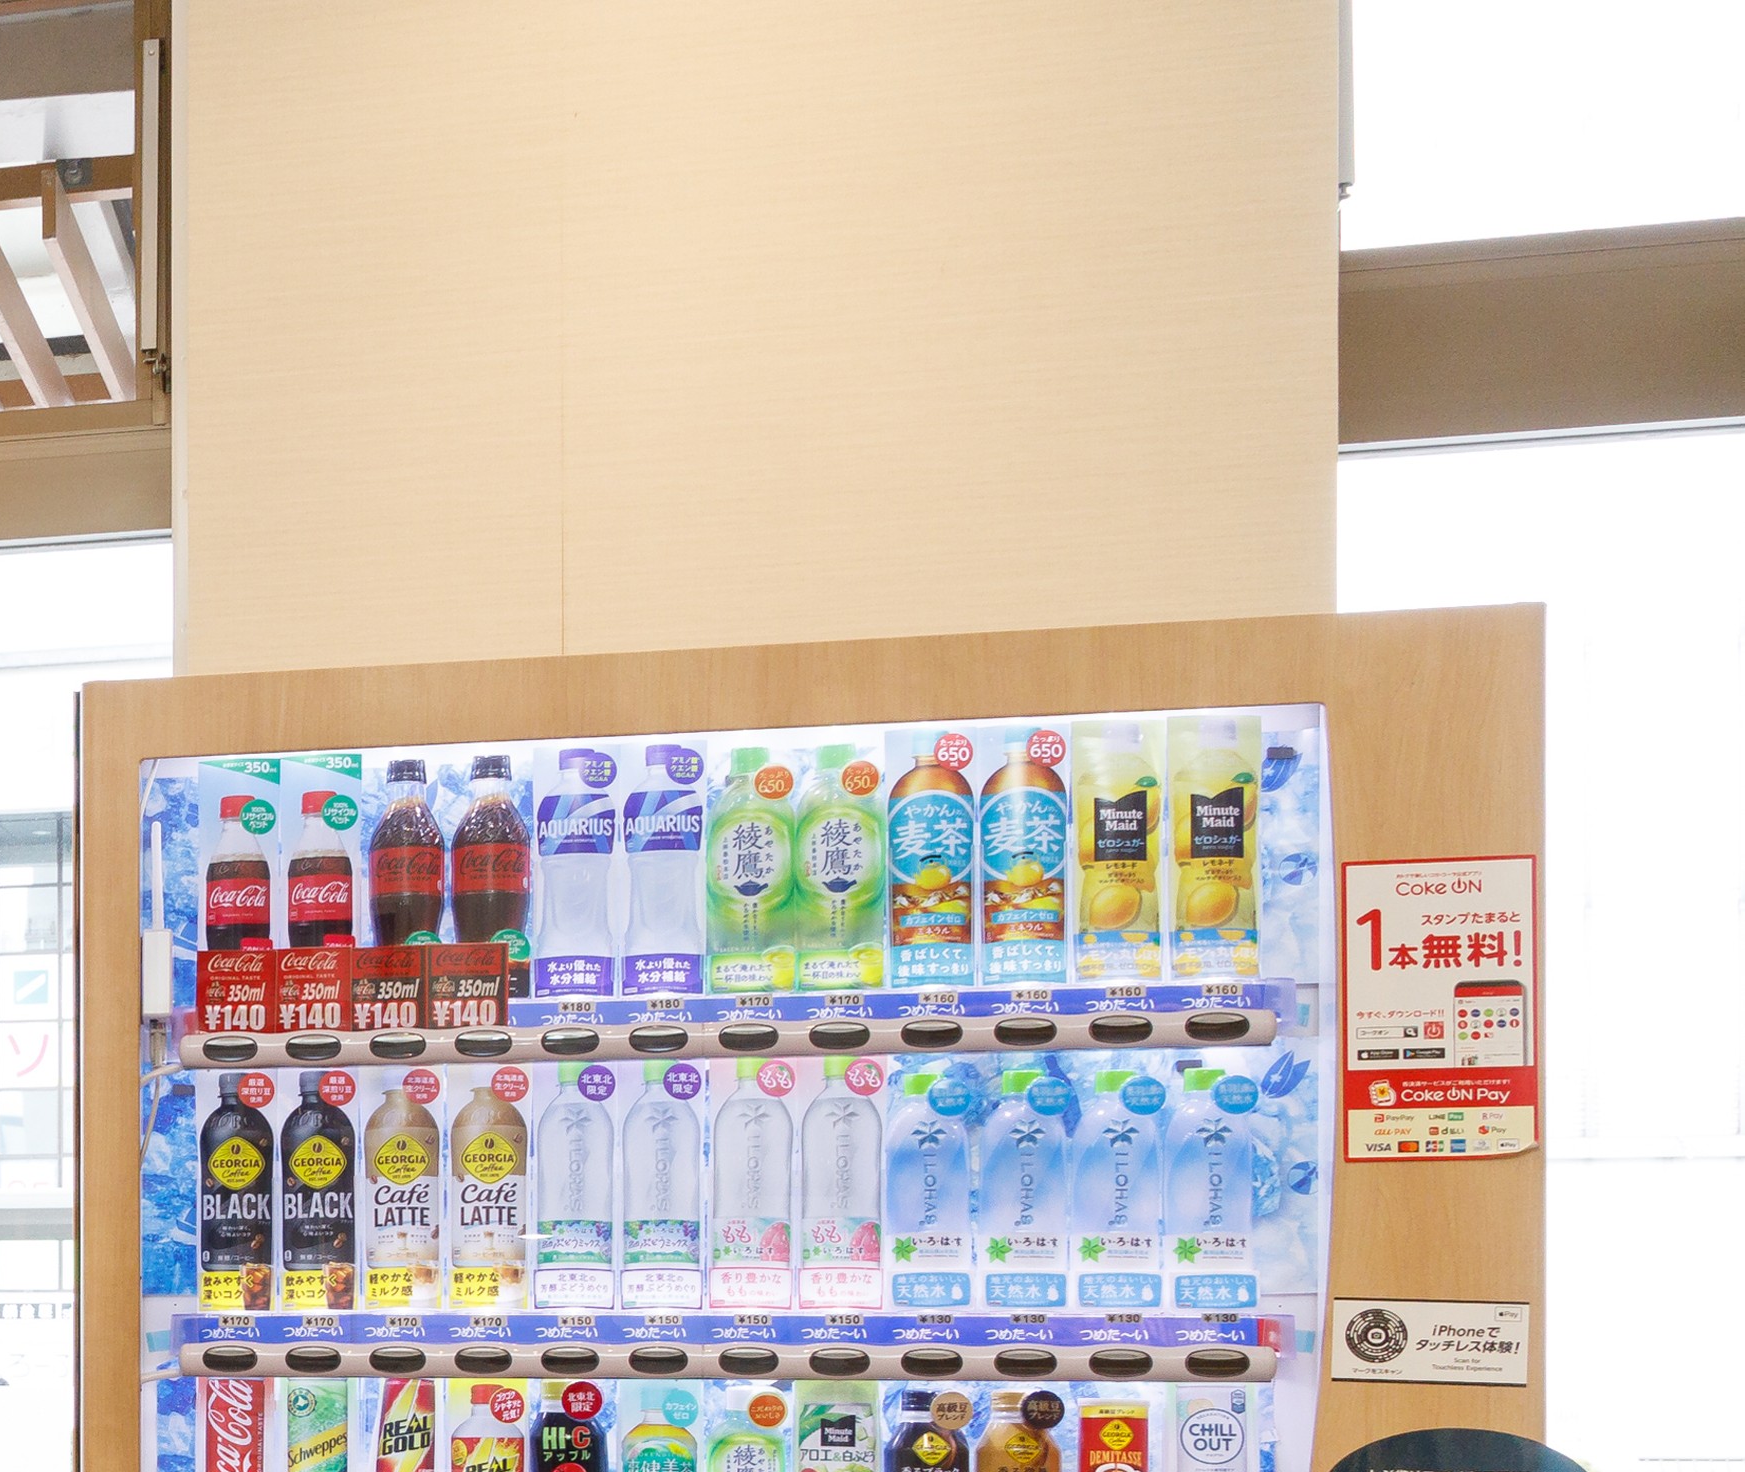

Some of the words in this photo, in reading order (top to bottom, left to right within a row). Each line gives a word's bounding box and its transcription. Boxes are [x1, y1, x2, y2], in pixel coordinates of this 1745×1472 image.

[937, 745, 971, 762] 650
[1029, 742, 1063, 760] 650
[1099, 807, 1144, 821] Minute
[1196, 804, 1241, 818] Minute
[539, 818, 614, 838] AQUARIUS
[625, 815, 702, 835] AQUARIUS
[1104, 818, 1138, 832] Maid
[1201, 814, 1235, 828] Maid
[892, 818, 971, 859] 麦茶
[983, 816, 1064, 856] 麦茶
[1096, 837, 1145, 849] ゼロシュガー
[1193, 834, 1242, 846] ゼロシュガー
[209, 882, 268, 909] Coca-Cola
[291, 881, 350, 906] Coca-Cola
[1395, 881, 1447, 896] Coke
[1421, 911, 1521, 926] スタンプたまると
[546, 960, 602, 974] 水より優れた
[634, 957, 692, 972] 水より優れた
[549, 972, 597, 986] 水分補給
[638, 971, 687, 985] 水分補給
[227, 979, 265, 1002] 350ml
[301, 978, 340, 1001] 350ml
[377, 978, 420, 1000] 350ml
[458, 976, 500, 998] 350ml
[204, 1003, 266, 1031] ¥140
[279, 1003, 341, 1030] ¥140
[1401, 1089, 1444, 1101] Coke
[1476, 1088, 1510, 1104] Pay
[1386, 1114, 1414, 1122] PayPay
[1365, 1143, 1392, 1152] VISA
[212, 1157, 262, 1169] GEORGIA
[293, 1156, 344, 1168] GEORGIA
[376, 1154, 426, 1165] GEORGIA
[463, 1153, 515, 1164] GEORGIA
[374, 1184, 430, 1206] Café
[460, 1182, 517, 1204] Café
[202, 1193, 271, 1221] BLACK
[284, 1191, 354, 1220] BLACK
[374, 1206, 431, 1228] LATTE
[460, 1204, 517, 1227] LATTE
[369, 1272, 413, 1286] 軽やかな
[454, 1272, 500, 1285] 軽やかな
[202, 1288, 244, 1301] 深いコク
[285, 1287, 327, 1300] 深いコク
[370, 1285, 413, 1298] ミルク感
[454, 1285, 500, 1297] ミルク感
[896, 1284, 948, 1300] 天然水
[990, 1284, 1042, 1300] 天然水
[1083, 1284, 1135, 1300] 天然水
[1179, 1285, 1232, 1301] 天然水
[1432, 1324, 1501, 1338] iPhoneで
[1415, 1339, 1521, 1355] タッチレス体験!
[383, 1413, 431, 1438] REAL
[1189, 1422, 1237, 1438] CHILL
[288, 1431, 348, 1468] Schweppes
[381, 1432, 431, 1457] GOLD
[1193, 1437, 1231, 1453] OUT
[543, 1450, 592, 1462] アップル
[1089, 1450, 1143, 1468] DEMITASSE
